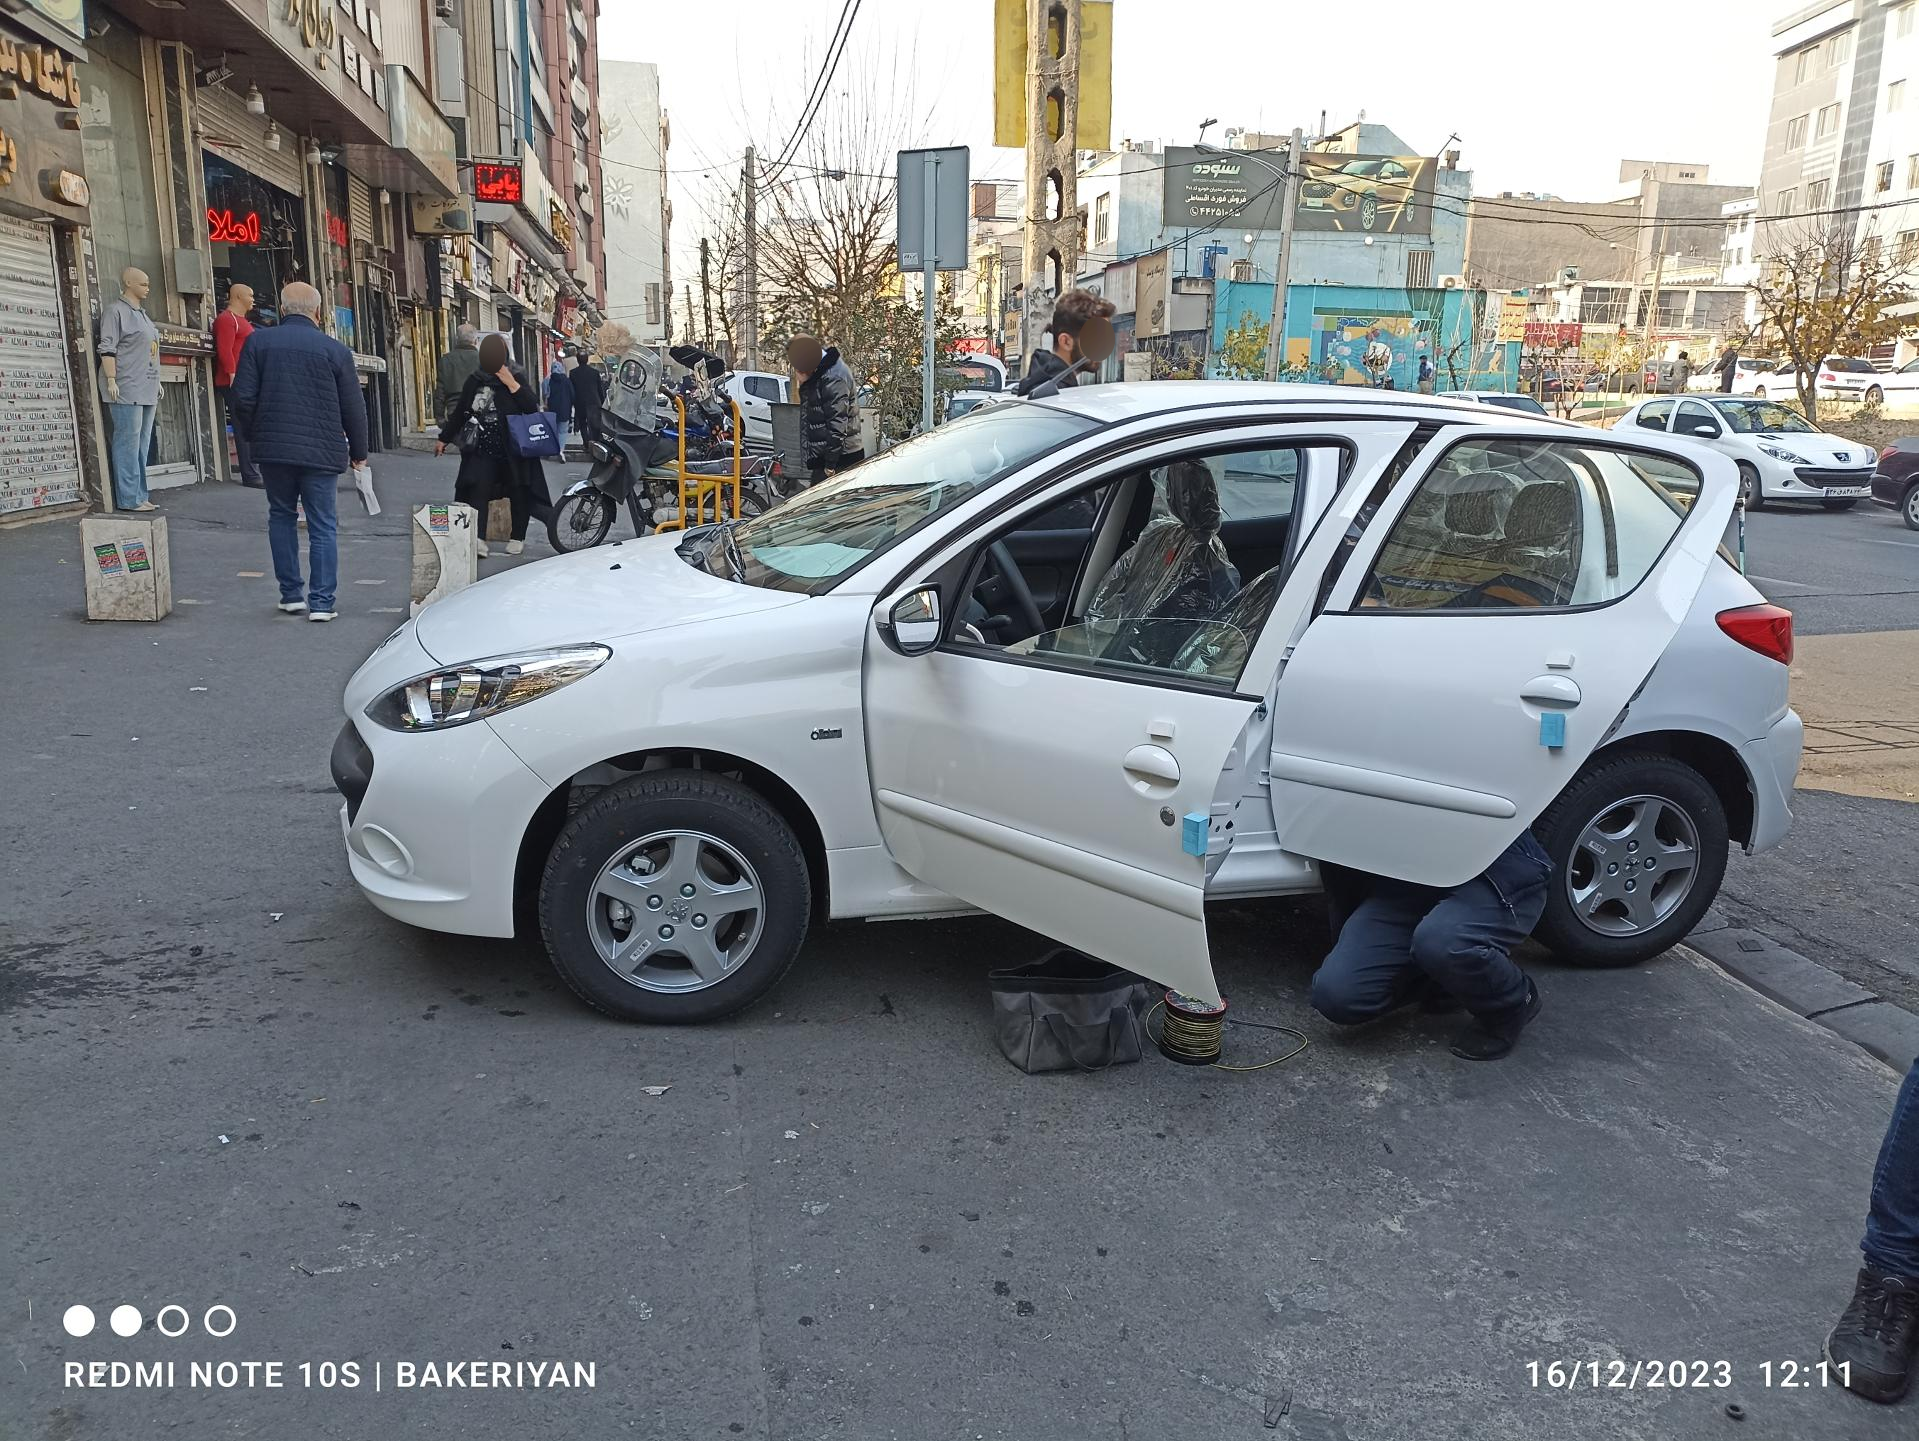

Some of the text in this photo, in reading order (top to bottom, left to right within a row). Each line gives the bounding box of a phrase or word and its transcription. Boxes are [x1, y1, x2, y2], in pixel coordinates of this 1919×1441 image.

[1192, 159, 1241, 178] ستوده
[1184, 193, 1247, 204] فروش فوری اقساطی
[207, 208, 259, 243] املا
